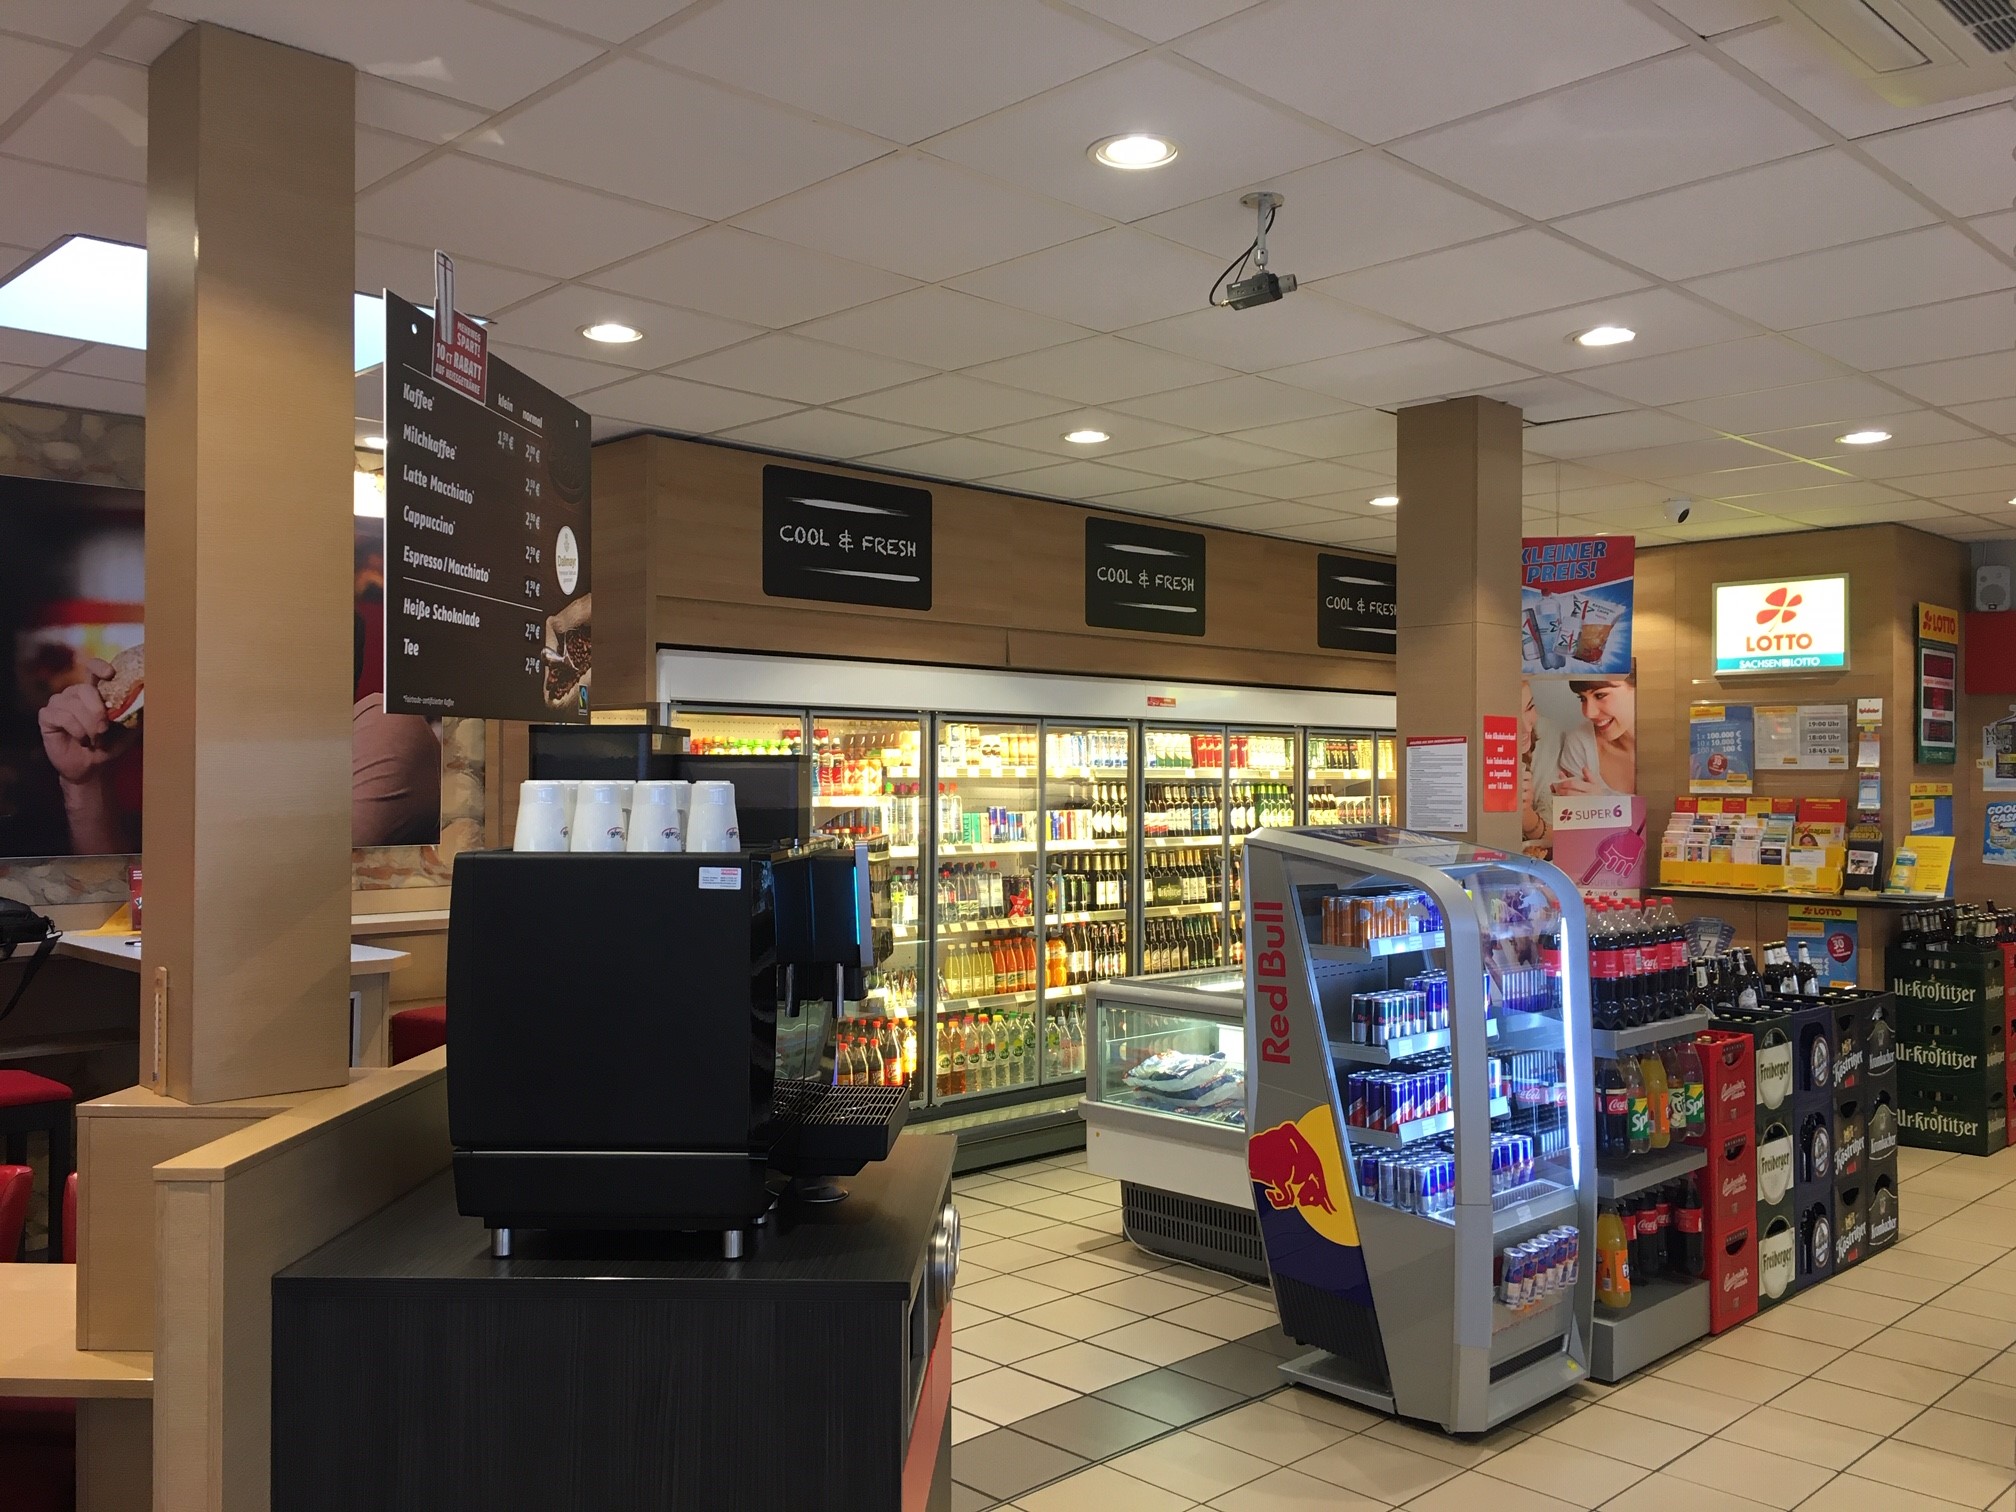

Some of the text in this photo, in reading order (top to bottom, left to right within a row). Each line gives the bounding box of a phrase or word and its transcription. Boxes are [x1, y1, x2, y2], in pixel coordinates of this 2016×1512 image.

[457, 332, 480, 358] SPART!
[436, 342, 446, 361] 10
[453, 351, 482, 381] RABATT
[522, 410, 542, 429] normal
[403, 464, 428, 488] Latte
[780, 525, 917, 557] COOL & FRESH
[1097, 566, 1194, 592] COOL & FRESH
[1525, 560, 1598, 584] PREIS!
[1325, 596, 1353, 610] COOL
[1356, 597, 1366, 614] &
[432, 604, 480, 628] Schokolade
[1932, 616, 1956, 635] LOTTO
[403, 638, 419, 656] Tee
[1746, 633, 1813, 652] LOTTO
[1827, 720, 1840, 728] Uhr
[1707, 731, 1735, 740] 100.000
[1827, 733, 1840, 741] Uhr
[1575, 804, 1623, 821] SUPER 6
[1814, 907, 1842, 917] LOTTO
[1832, 939, 1845, 950] 30
[1253, 902, 1291, 1064] Red Bull
[1760, 1061, 1790, 1082] Freiberger
[1761, 1153, 1790, 1175] Freiberger
[1763, 1247, 1793, 1273] Freiberger
